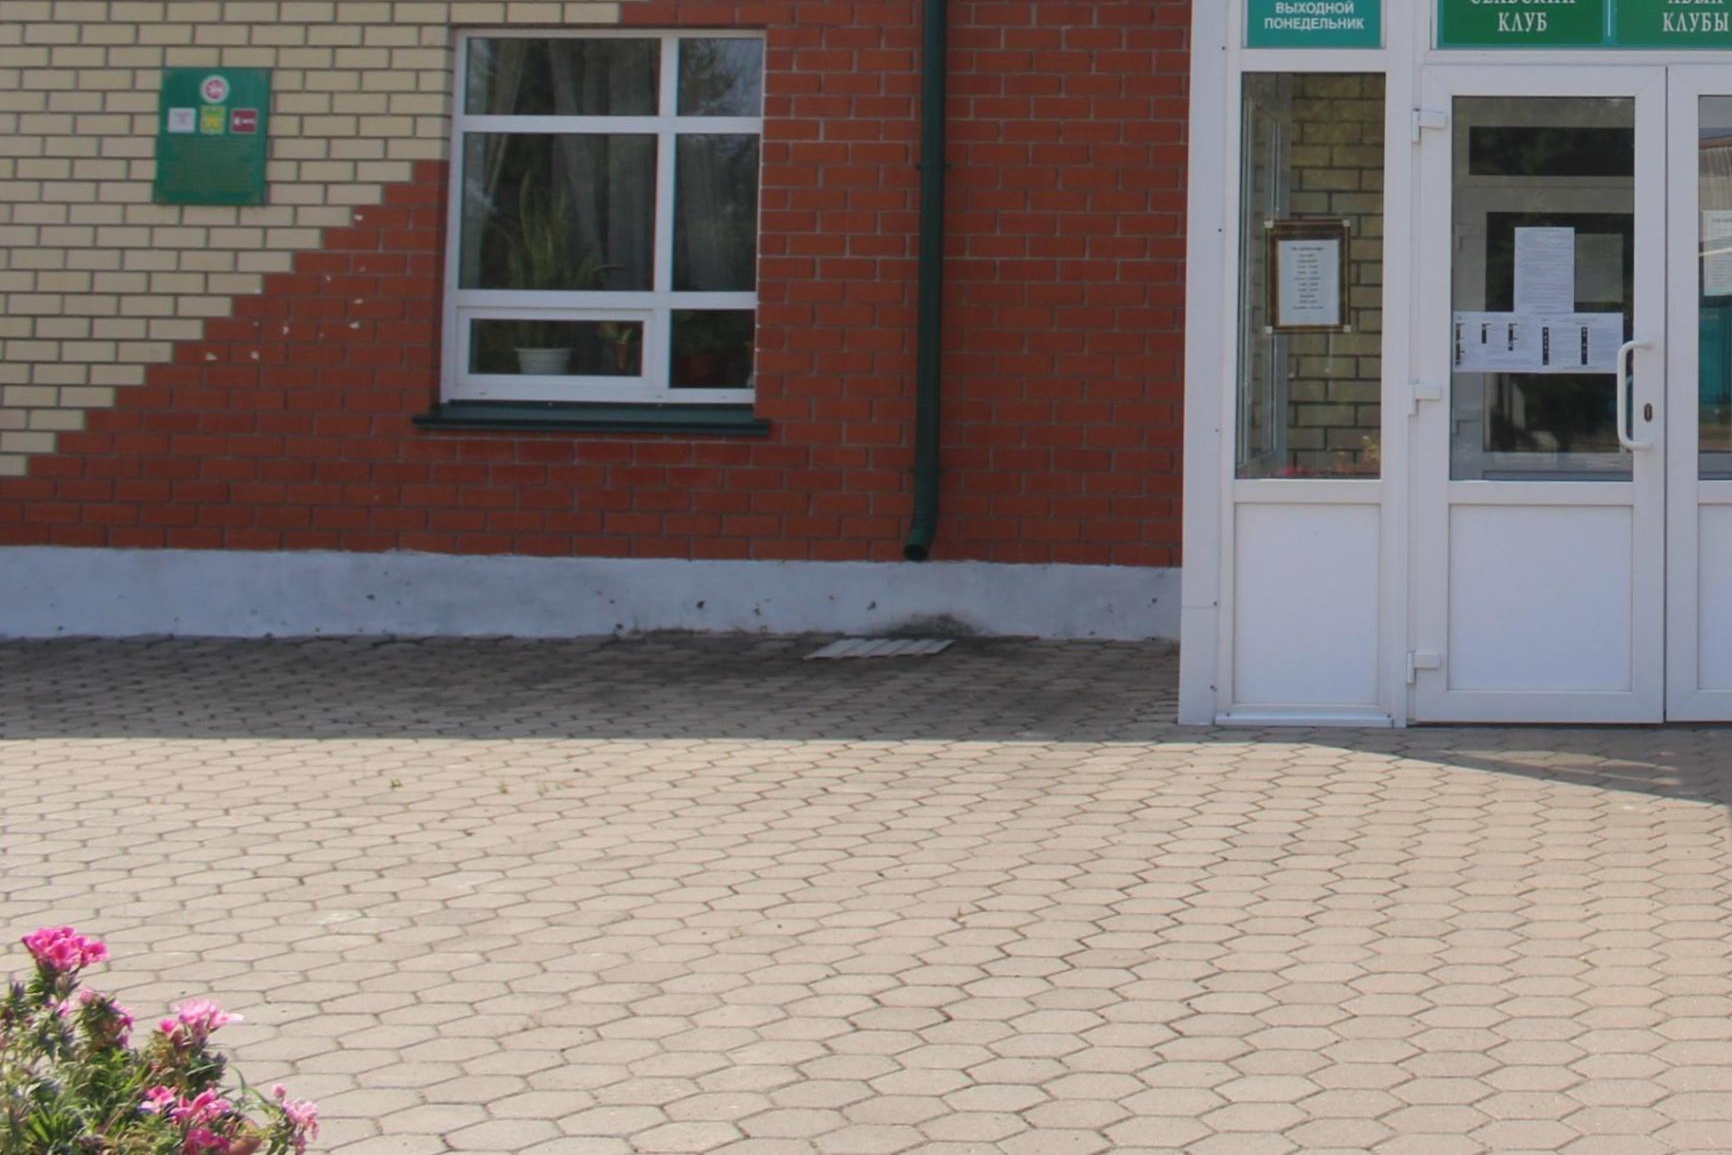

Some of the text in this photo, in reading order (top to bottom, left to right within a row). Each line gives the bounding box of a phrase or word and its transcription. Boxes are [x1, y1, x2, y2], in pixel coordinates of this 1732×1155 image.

[1275, 0, 1354, 15] ВЫХОДНОЙ
[1263, 17, 1365, 31] ПОНЕДЕЛЬНИК
[1498, 12, 1548, 32] КЛУБ
[1662, 12, 1730, 33] КЛУБЫ
